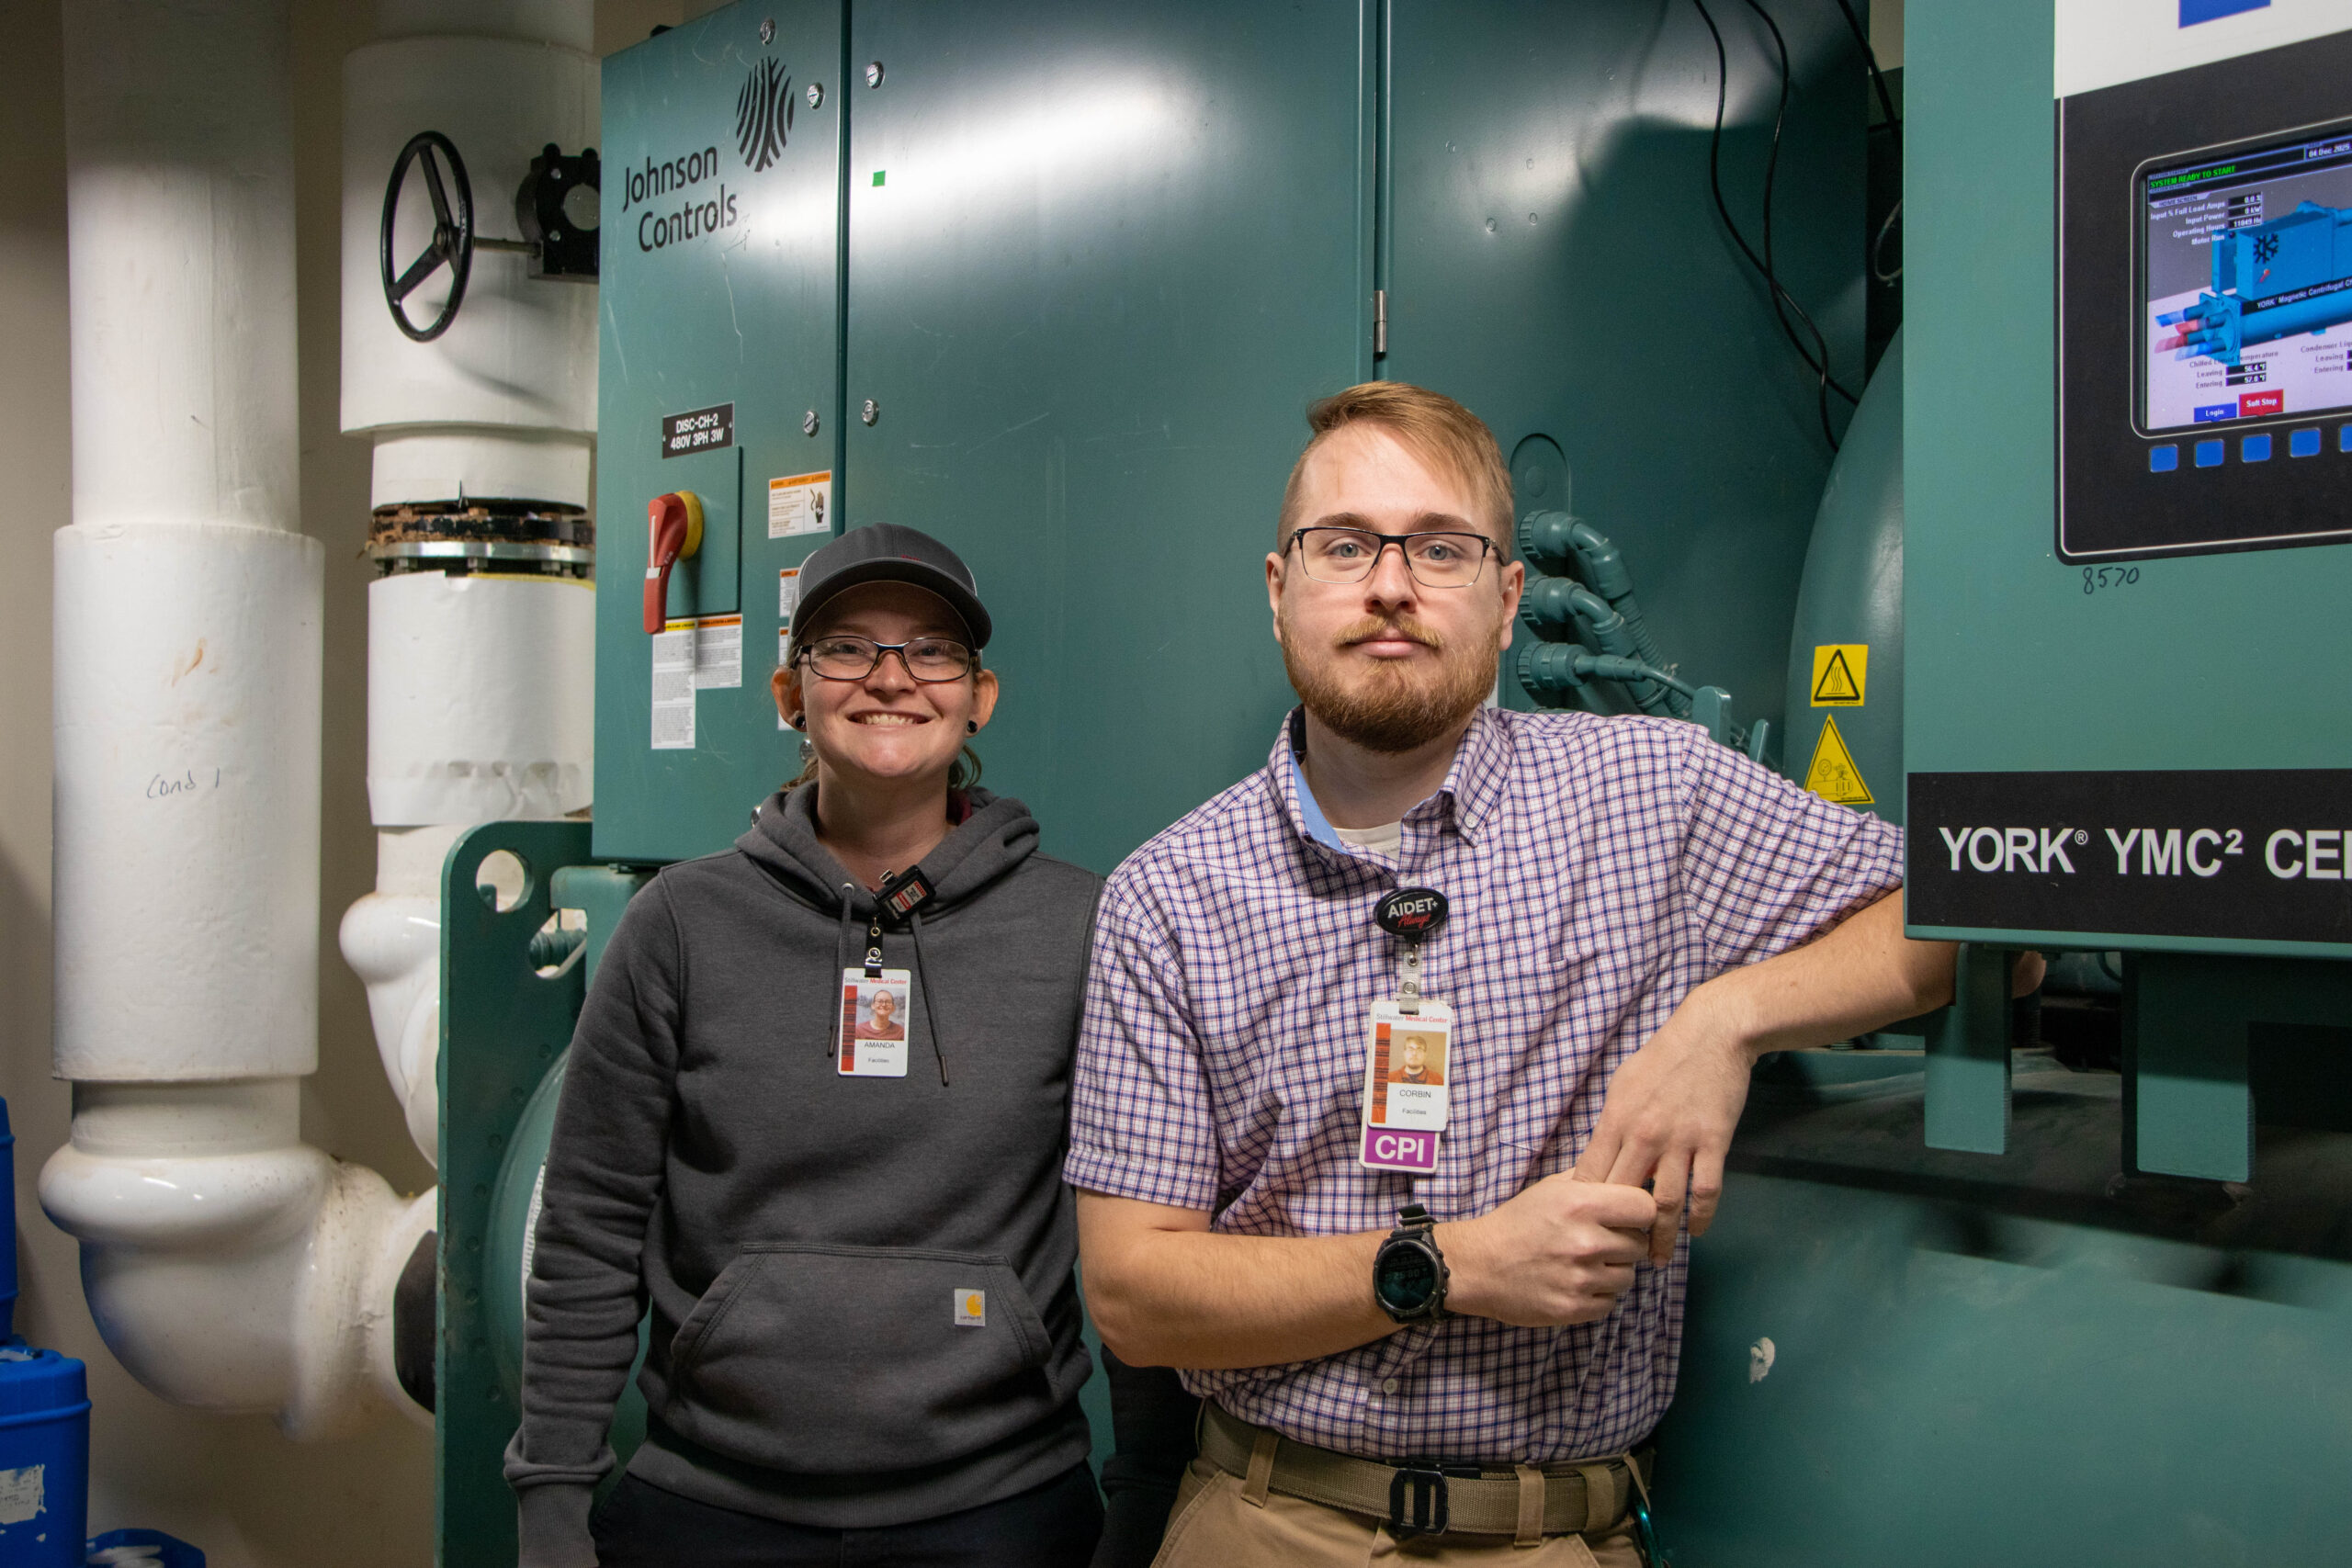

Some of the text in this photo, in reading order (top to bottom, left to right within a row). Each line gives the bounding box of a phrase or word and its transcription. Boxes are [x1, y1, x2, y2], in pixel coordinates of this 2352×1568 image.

[2318, 148, 2332, 156] Dec
[622, 146, 718, 213] Johnson
[2151, 176, 2177, 188] SYSTEM
[2178, 172, 2200, 184] READY
[2202, 170, 2211, 178] TO
[2213, 165, 2235, 177] START
[2150, 210, 2166, 220] Input
[2175, 207, 2187, 216] Full
[2188, 203, 2205, 213] Load
[2206, 201, 2225, 210] Amps
[639, 184, 737, 252] Controls
[2186, 214, 2202, 225] Input
[2203, 212, 2225, 221] Power
[2173, 226, 2205, 239] Operating
[2206, 223, 2225, 231] Hours
[2191, 233, 2225, 245] Motor Run
[2278, 292, 2307, 304] Magnetic
[2308, 281, 2344, 296] Centrifugal
[2301, 343, 2337, 353] Condenser
[2189, 359, 2212, 368] Chilled
[2315, 354, 2344, 363] Leaving
[2197, 369, 2222, 378] Leaving
[2314, 365, 2344, 374] Entering
[2196, 380, 2222, 389] Entering
[2246, 398, 2278, 408] Soft Stop
[2205, 409, 2224, 418] Login
[675, 413, 718, 434] DISC-CH-2
[671, 427, 724, 450] 480V 3PH 3W
[2083, 566, 2140, 595] 8570
[2105, 828, 2244, 877] YMC²
[2265, 829, 2352, 880] CE
[1397, 912, 1431, 930] Always
[1376, 1013, 1405, 1021] Stillwater
[1399, 1089, 1431, 1099] CORBIN
[1374, 1134, 1425, 1162] CPI
